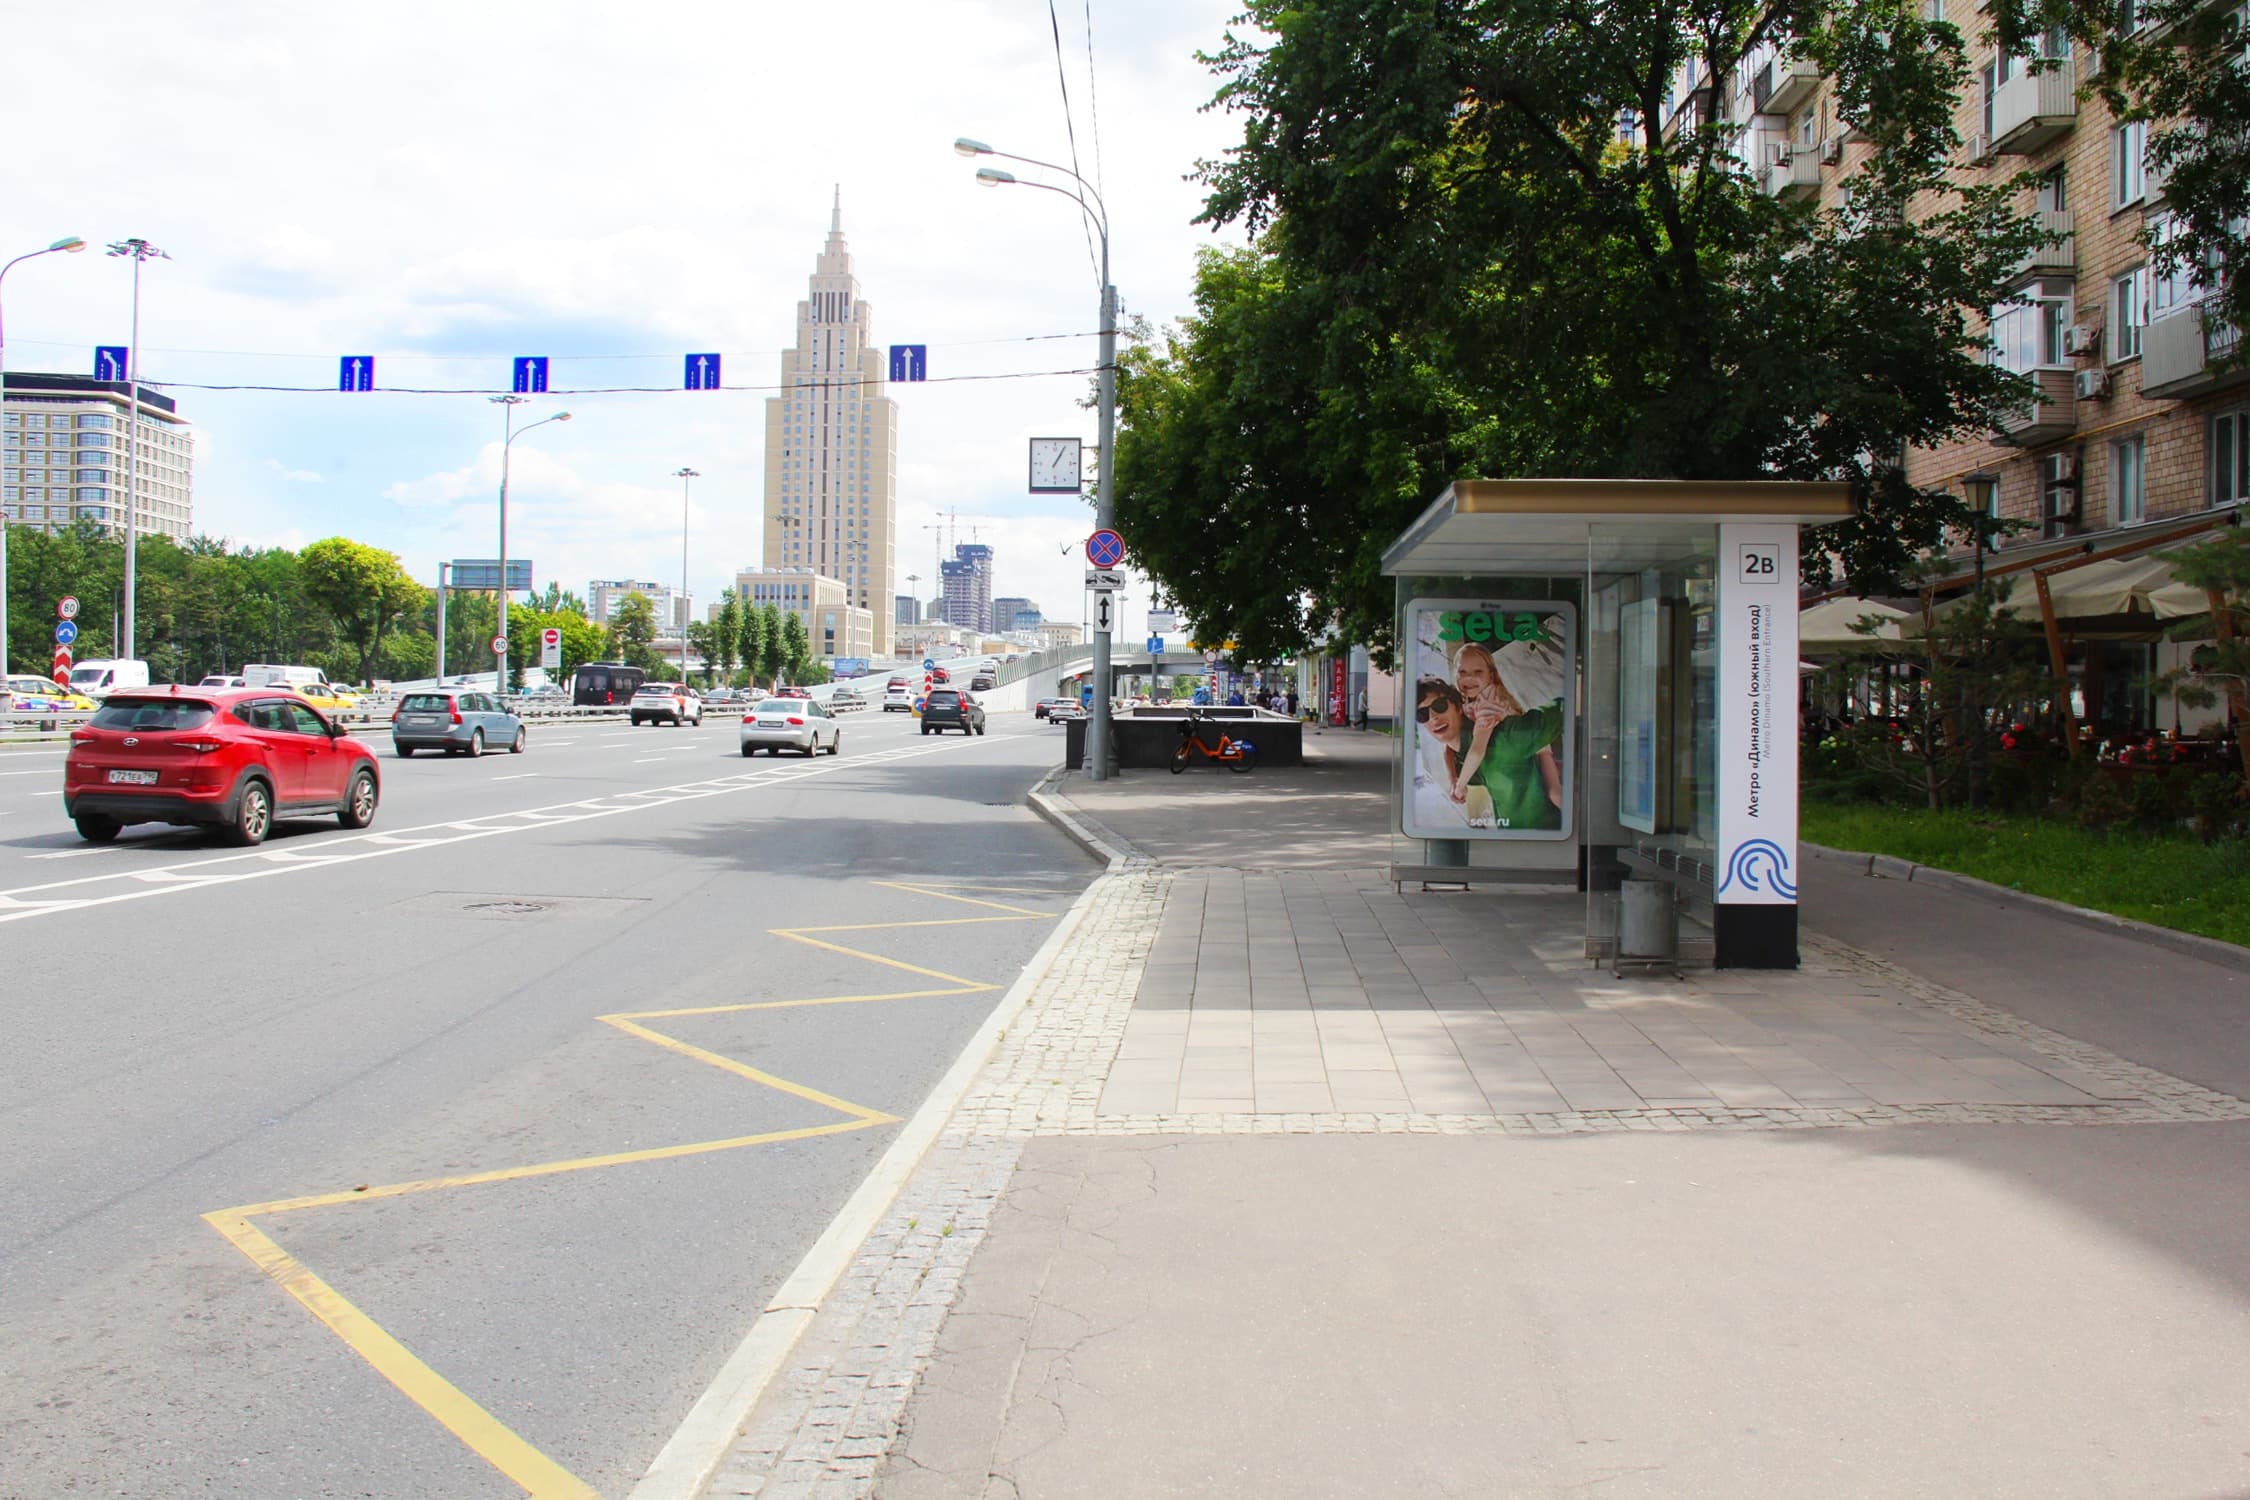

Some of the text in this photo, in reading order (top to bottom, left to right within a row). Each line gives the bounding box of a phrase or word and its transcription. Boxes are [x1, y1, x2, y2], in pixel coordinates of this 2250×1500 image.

[495, 640, 506, 650] 60
[1747, 604, 1761, 818] Метро «Динамо» (южный вход)
[1762, 604, 1771, 759] Metro Dinamo (Southern Entrance)
